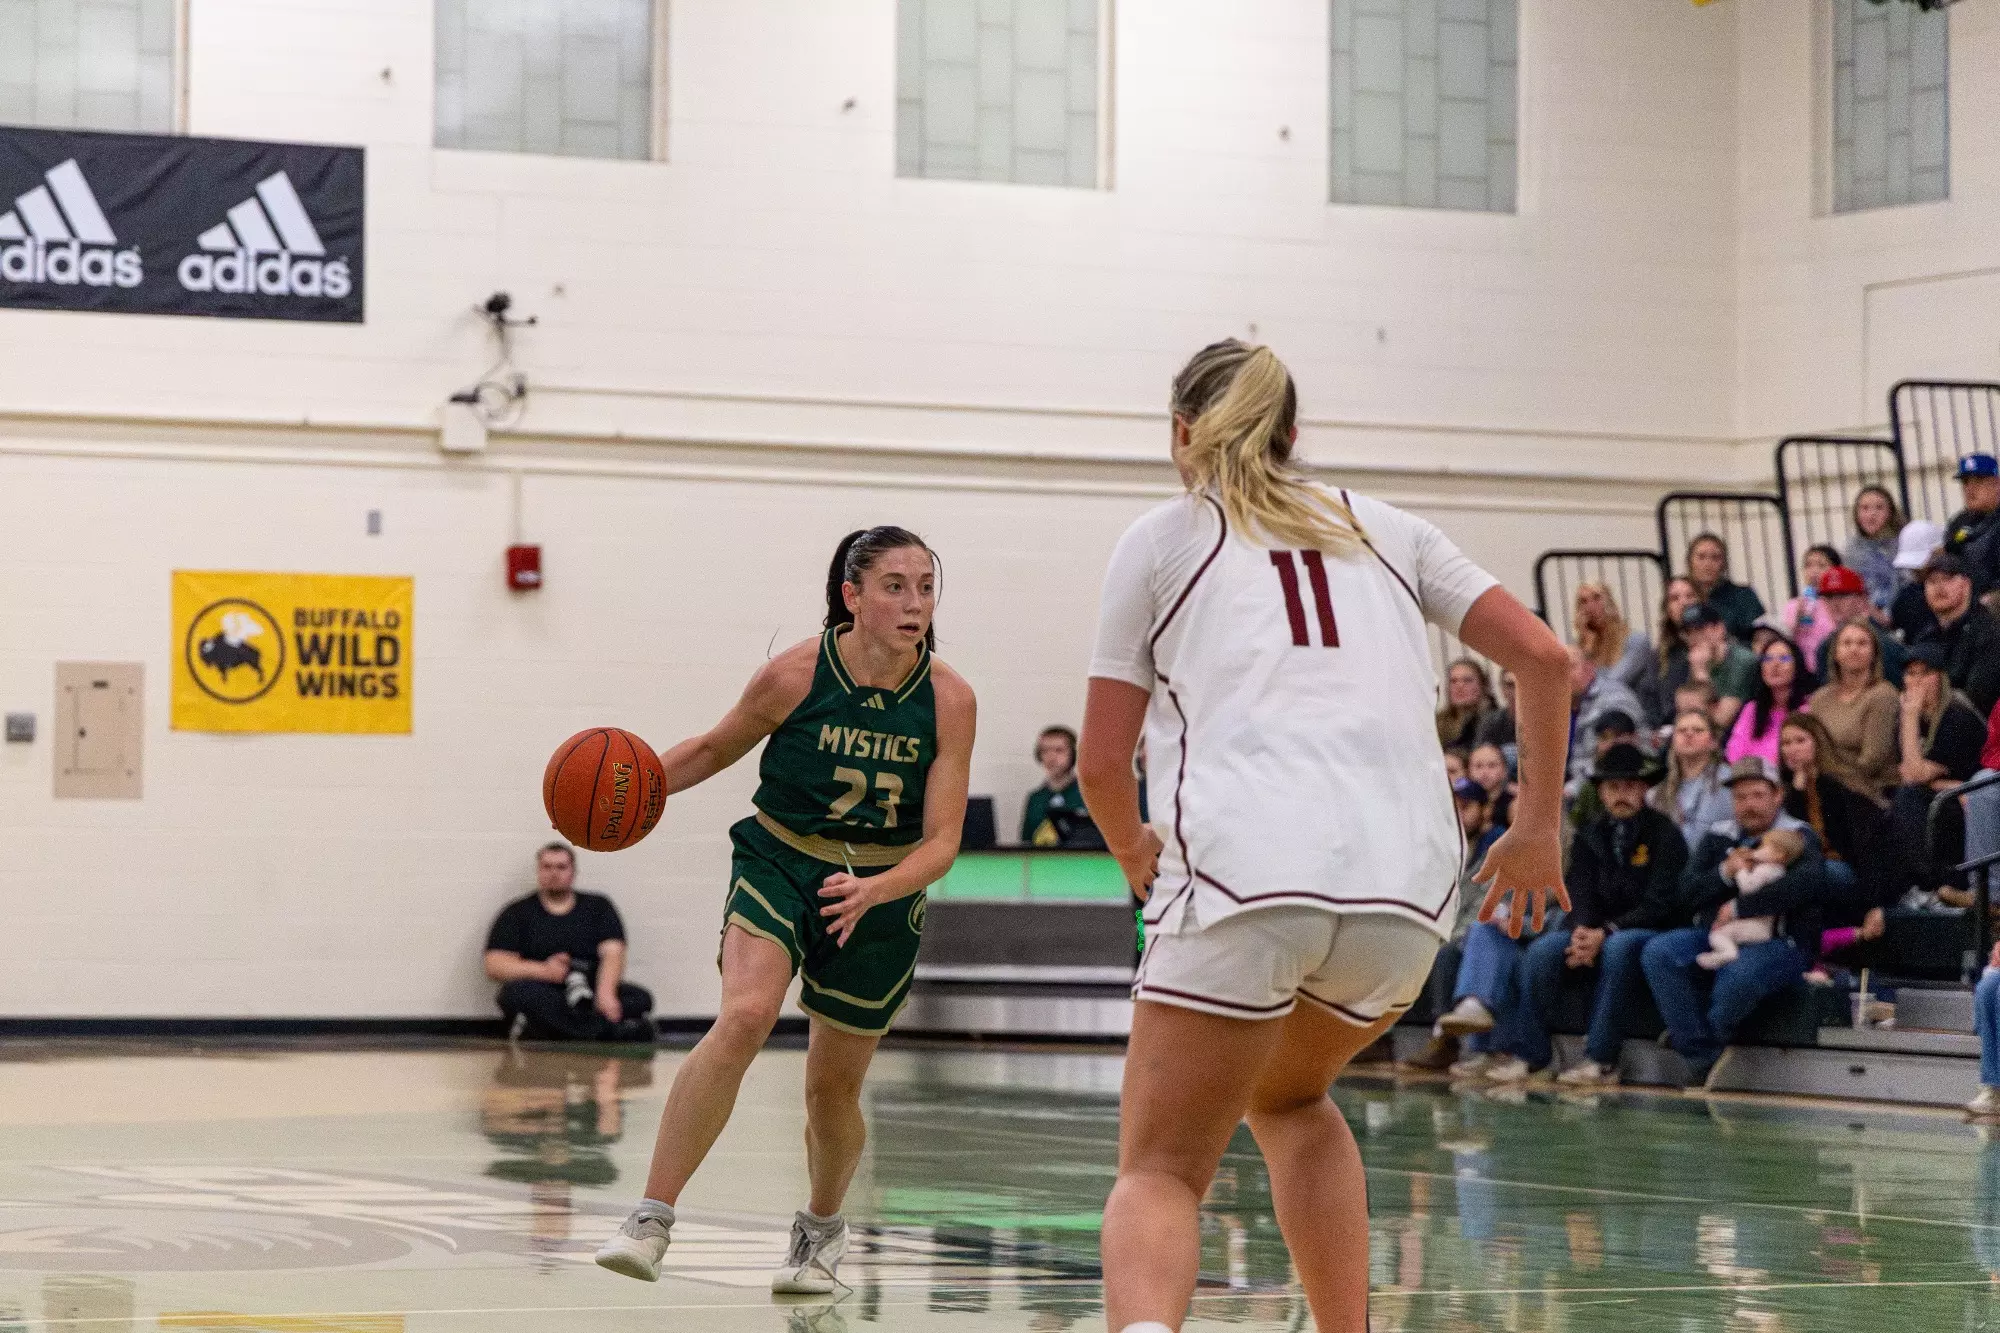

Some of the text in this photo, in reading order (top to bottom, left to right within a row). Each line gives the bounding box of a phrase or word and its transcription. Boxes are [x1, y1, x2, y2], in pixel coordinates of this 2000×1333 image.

[0, 239, 143, 287] didas
[178, 251, 350, 298] adidas
[294, 607, 399, 629] BUFFALO
[1269, 549, 1340, 648] 11
[295, 632, 399, 667] WILD
[296, 671, 399, 698] WINGS
[818, 724, 920, 763] MYSTICS
[600, 762, 632, 840] SPALDING
[825, 765, 904, 829] 23
